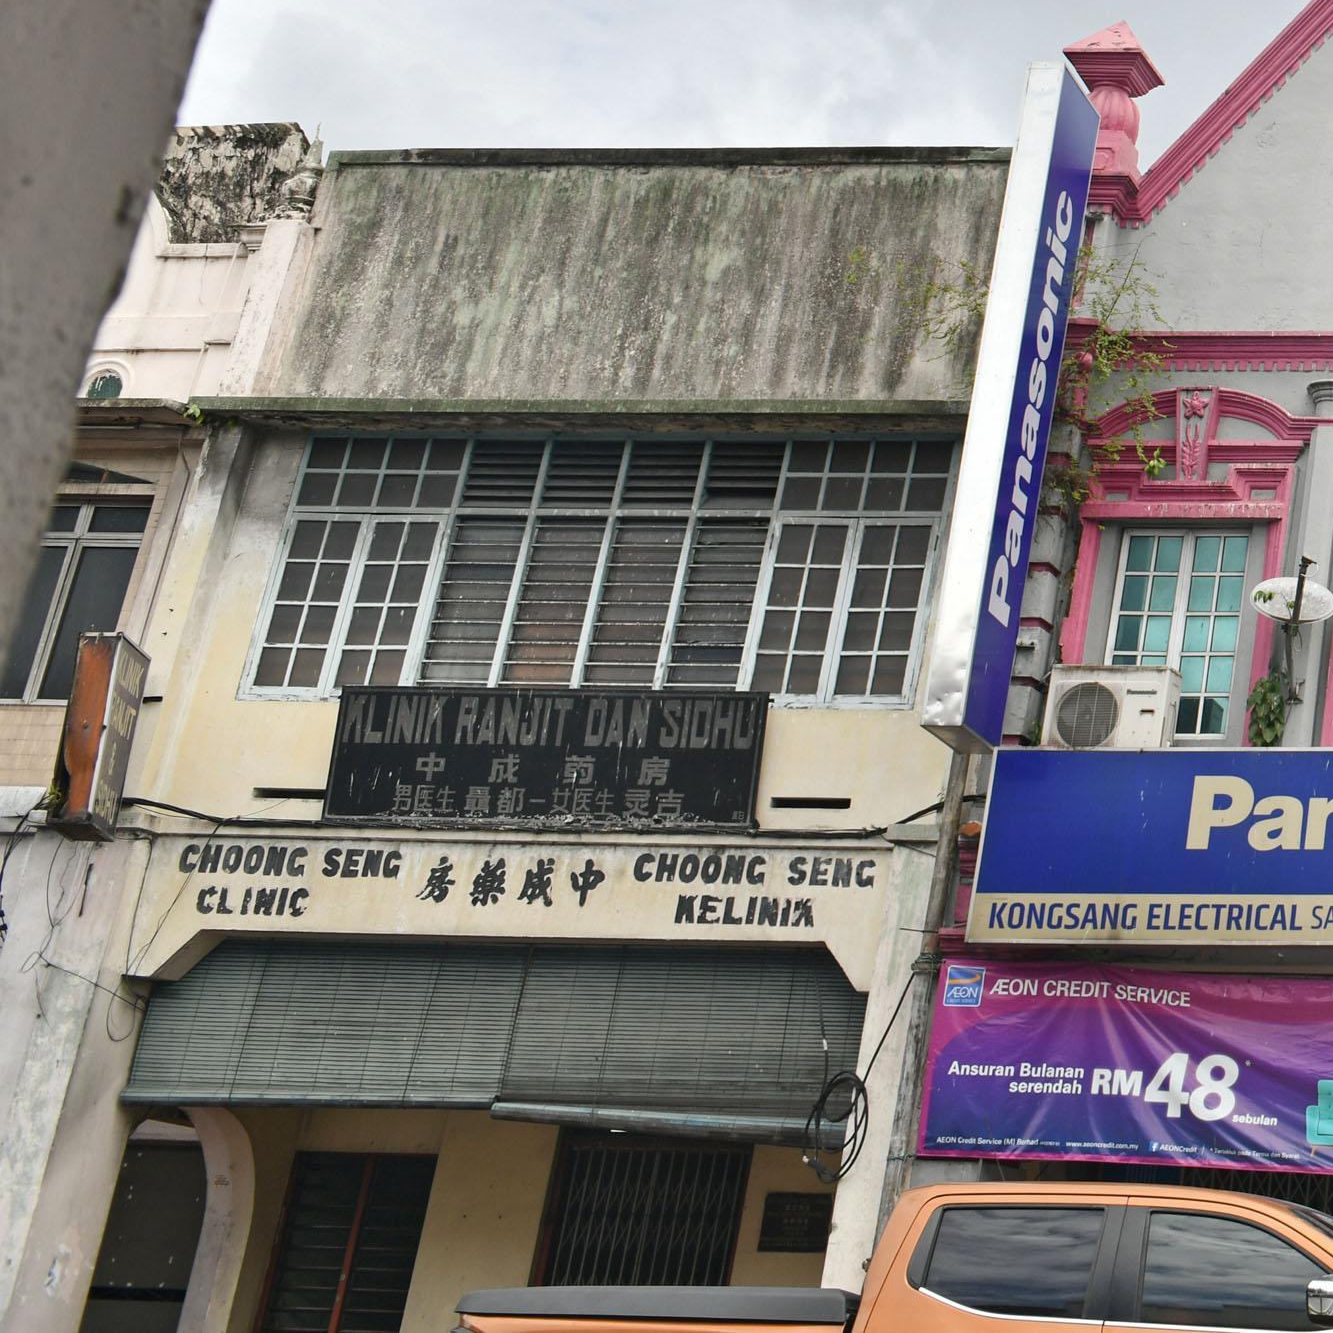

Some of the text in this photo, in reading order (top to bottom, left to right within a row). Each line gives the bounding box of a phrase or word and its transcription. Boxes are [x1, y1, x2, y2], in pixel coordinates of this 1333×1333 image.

[988, 189, 1074, 629] Panasonic
[342, 694, 757, 750] KLINIK RANJIT DAN SIDHU
[178, 843, 403, 880] CHOONG SENG
[633, 853, 876, 888] CHOONG SENG
[196, 885, 309, 916] CLINIC
[674, 894, 815, 928] KELINIK
[988, 901, 1138, 932] KONGSANG
[1146, 902, 1304, 932] ELECTRICAL
[1044, 980, 1111, 998] CREDIT
[1115, 983, 1191, 1007] SERVICE
[948, 1061, 1085, 1079] Ansuran Bulanan
[1009, 1079, 1082, 1094] serendah
[1232, 1114, 1278, 1126] sebulan
